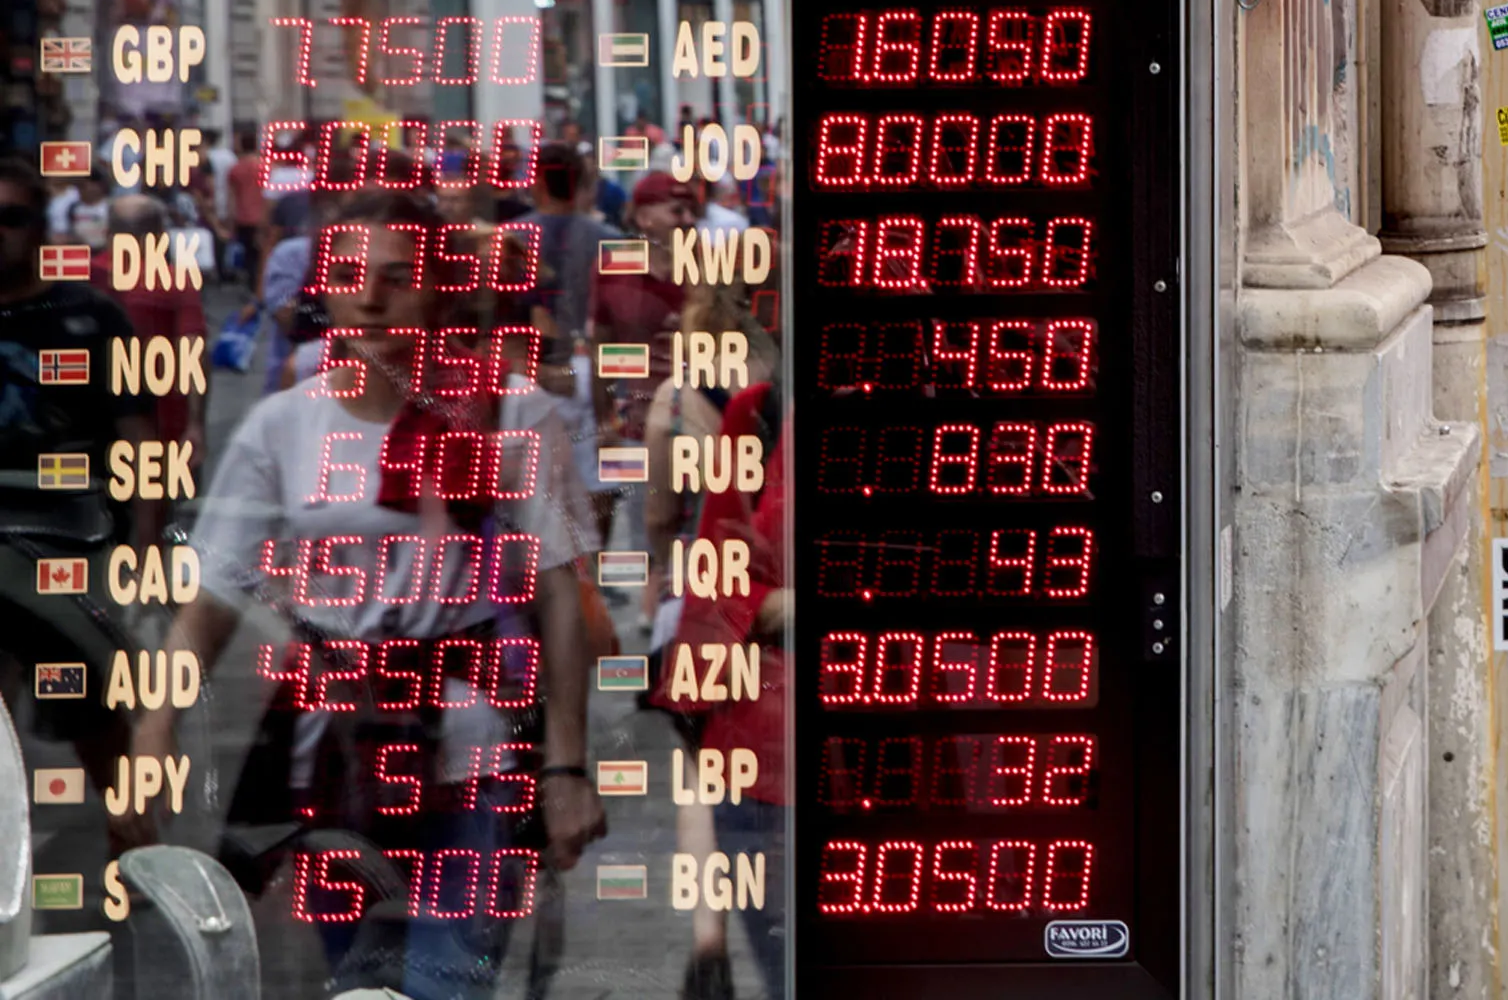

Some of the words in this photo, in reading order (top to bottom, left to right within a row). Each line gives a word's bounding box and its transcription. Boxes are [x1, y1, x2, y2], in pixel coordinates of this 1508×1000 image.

[113, 25, 206, 84] GBP
[672, 21, 761, 78] AED
[112, 129, 201, 187] CHF
[671, 123, 761, 183] JOD
[112, 232, 203, 291] DKK
[672, 227, 771, 286] KWD
[111, 336, 207, 396] NOK
[673, 331, 748, 389] IRR
[108, 440, 196, 500] SEK
[673, 434, 764, 493] RUB
[108, 544, 200, 605] CAD
[671, 539, 751, 601] IQR
[107, 650, 200, 709] AUD
[671, 643, 760, 703] AZN
[105, 755, 190, 816] JPY
[671, 748, 758, 805] LBP
[671, 852, 765, 911] BGN
